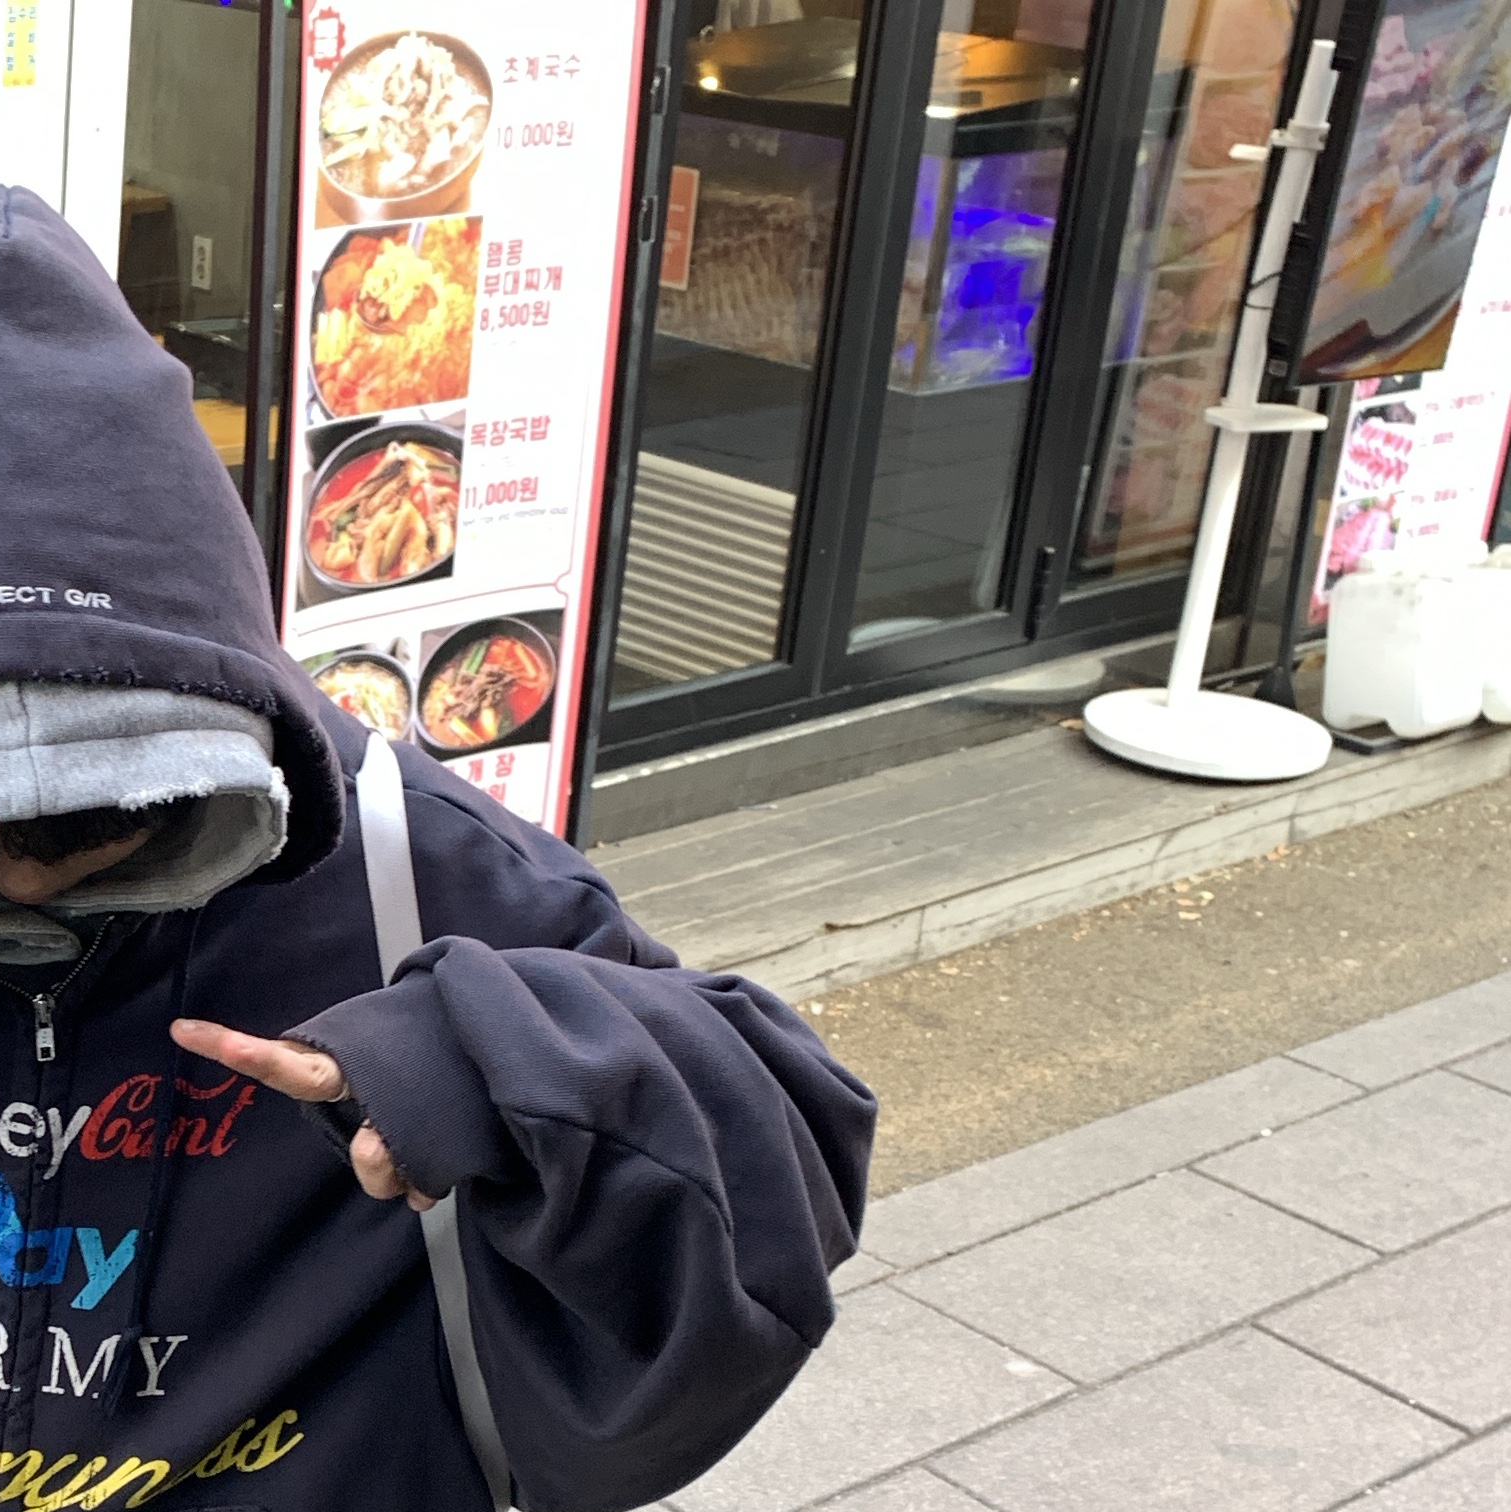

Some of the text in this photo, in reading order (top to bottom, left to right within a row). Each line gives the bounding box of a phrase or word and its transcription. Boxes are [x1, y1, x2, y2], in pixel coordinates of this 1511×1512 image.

[483, 266, 563, 298] 부대찌개
[480, 300, 550, 332] 8,500원
[465, 476, 539, 510] 11,000원
[64, 588, 114, 610] G/R
[448, 752, 516, 782] 개장
[41, 1326, 188, 1400] MY
